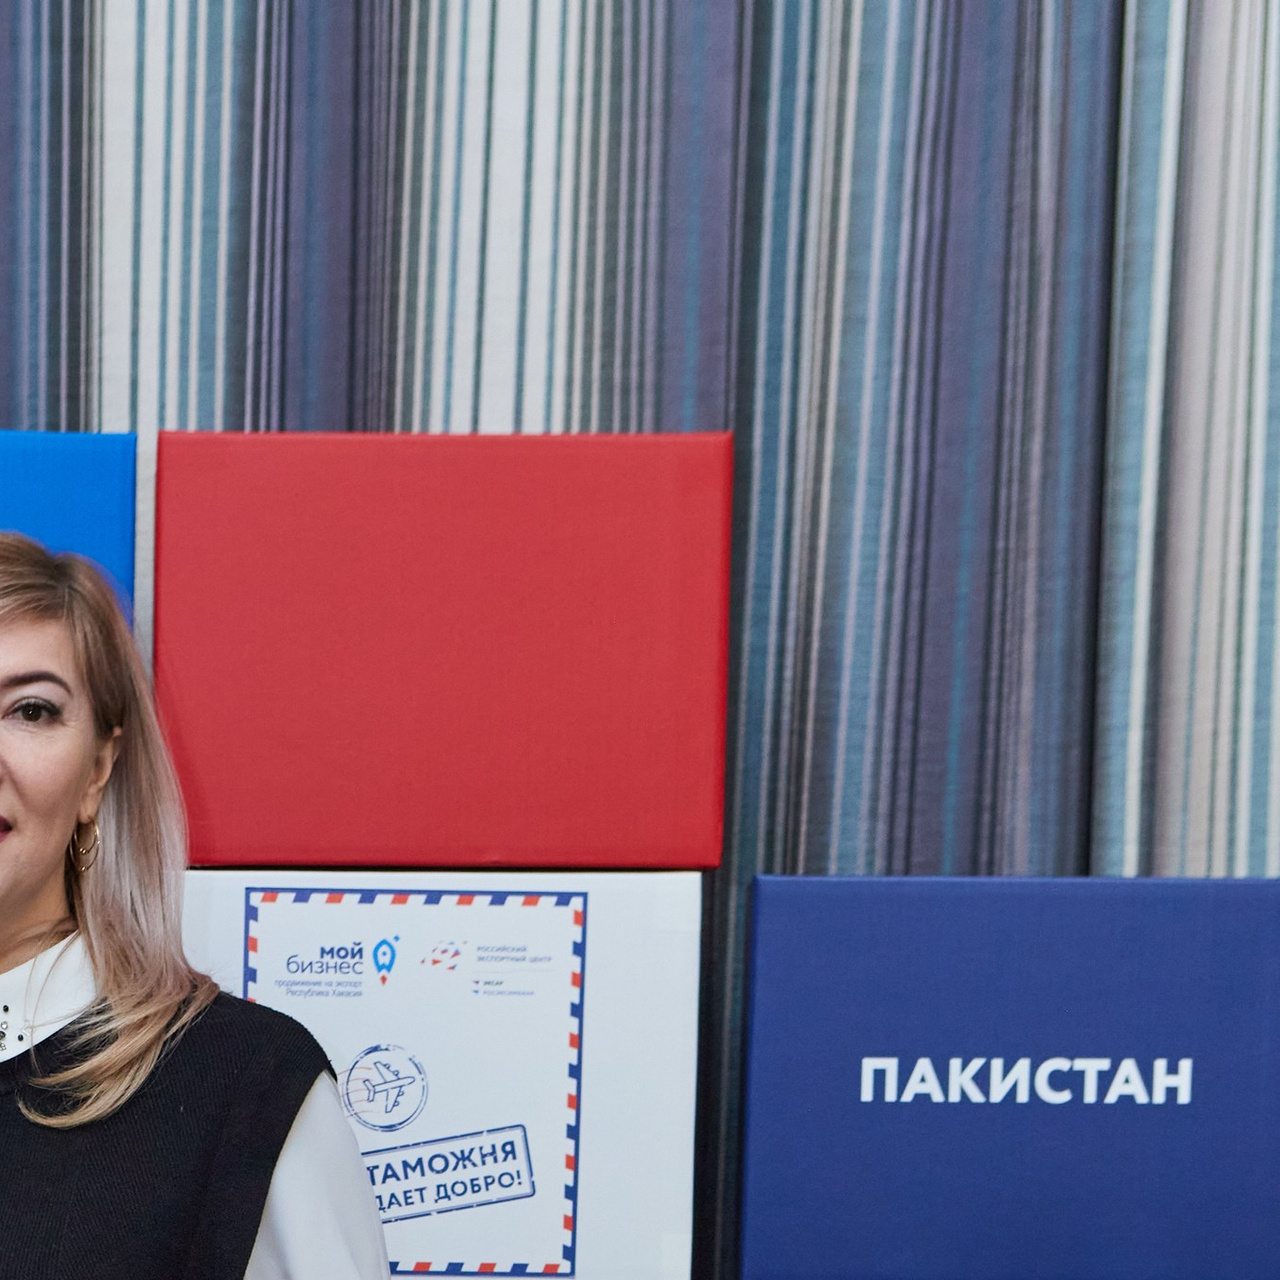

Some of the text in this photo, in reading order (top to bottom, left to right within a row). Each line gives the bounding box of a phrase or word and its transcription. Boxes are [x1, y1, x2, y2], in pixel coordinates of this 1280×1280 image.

[286, 954, 363, 975] бизнес
[320, 941, 363, 960] мой
[860, 1057, 1193, 1105] ПАКИСТАН
[366, 1140, 518, 1187] ТАМОЖНЯ
[434, 1169, 523, 1203] ДОБРО!
